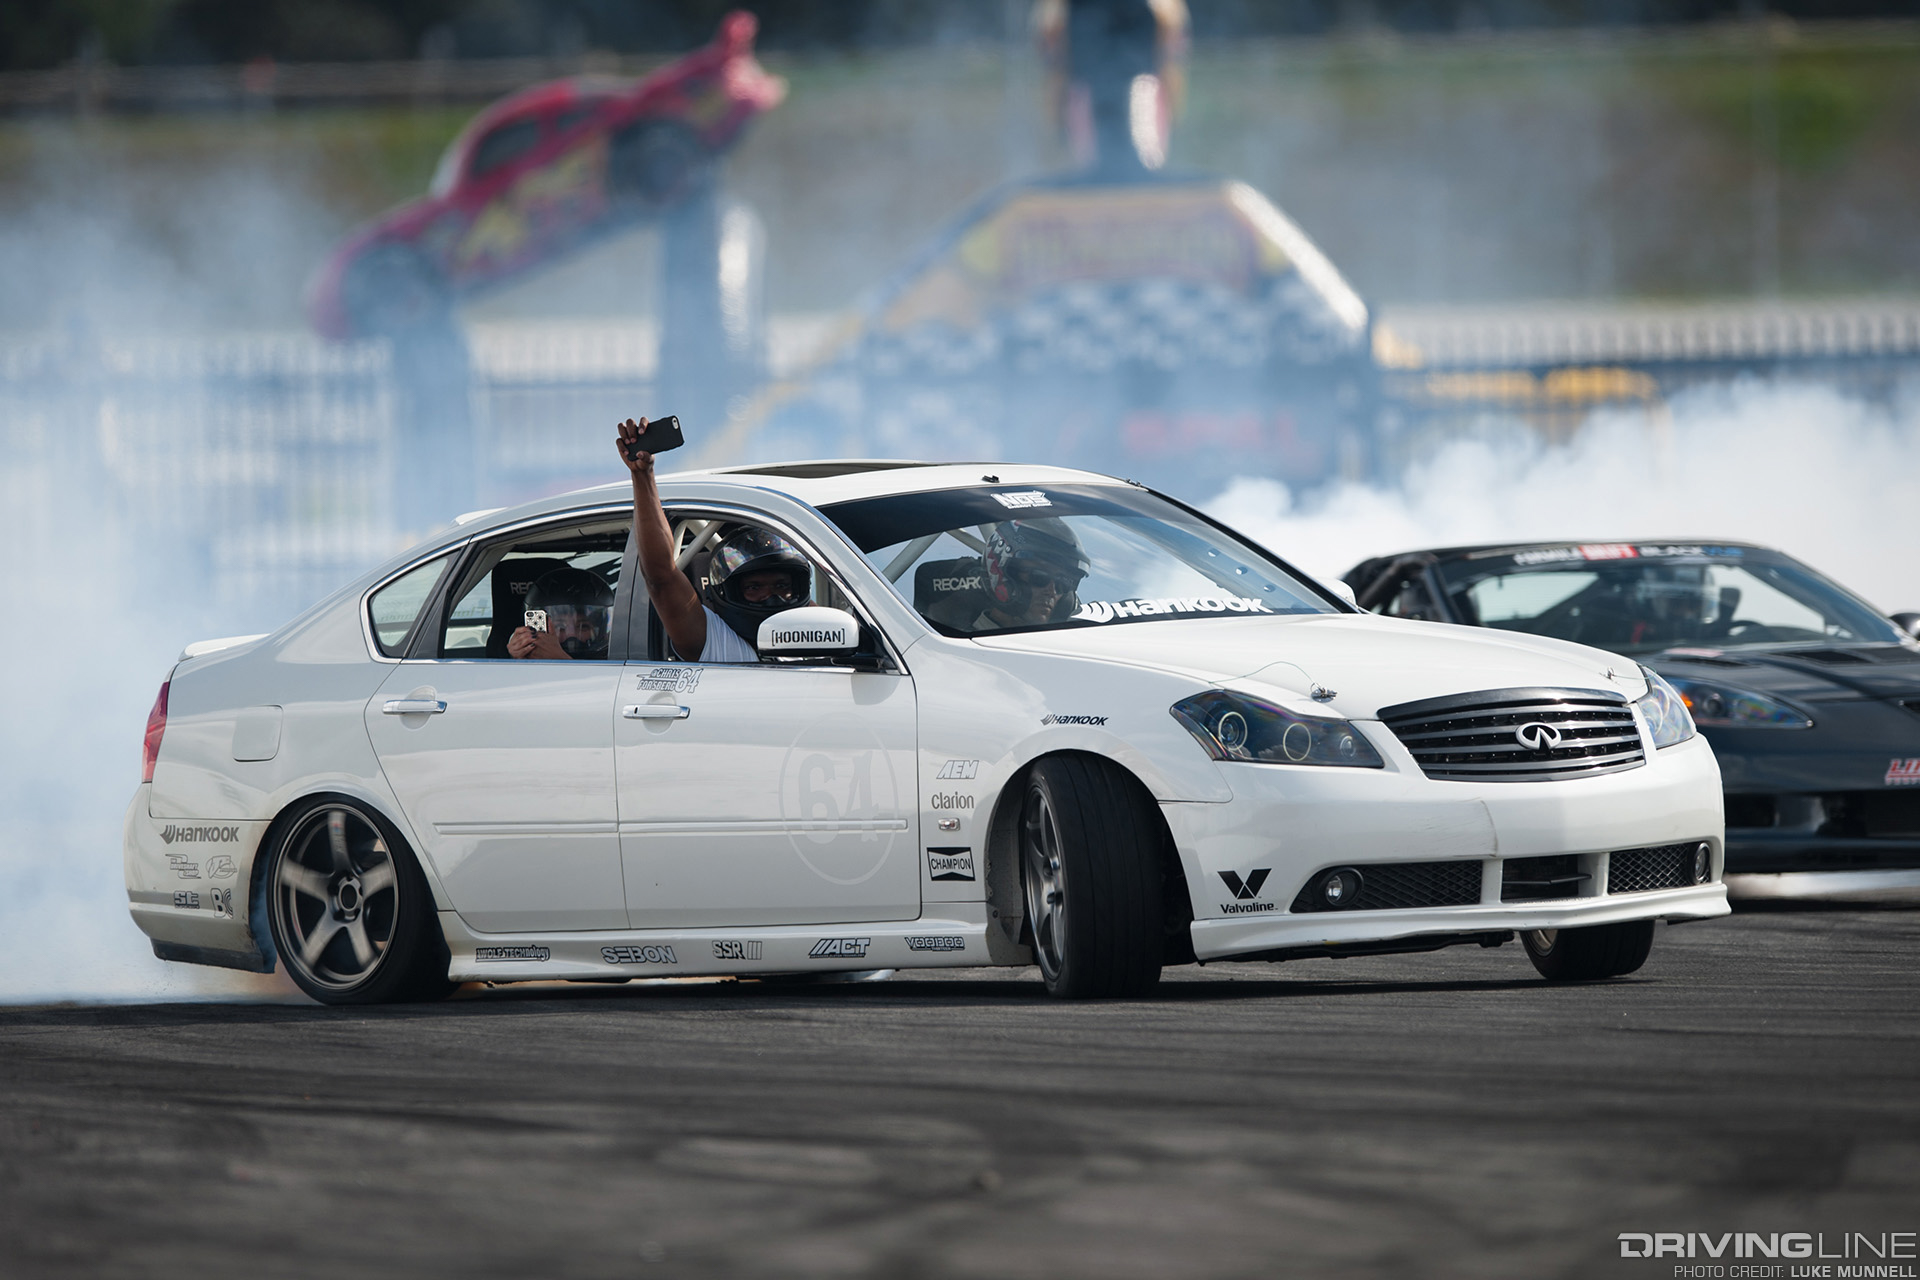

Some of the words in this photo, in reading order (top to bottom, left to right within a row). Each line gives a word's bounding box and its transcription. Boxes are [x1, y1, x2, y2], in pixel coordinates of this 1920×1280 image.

[936, 760, 980, 780] AEM
[931, 791, 975, 810] Clarion
[930, 858, 972, 870] CHAMPION
[712, 940, 746, 960] SSR
